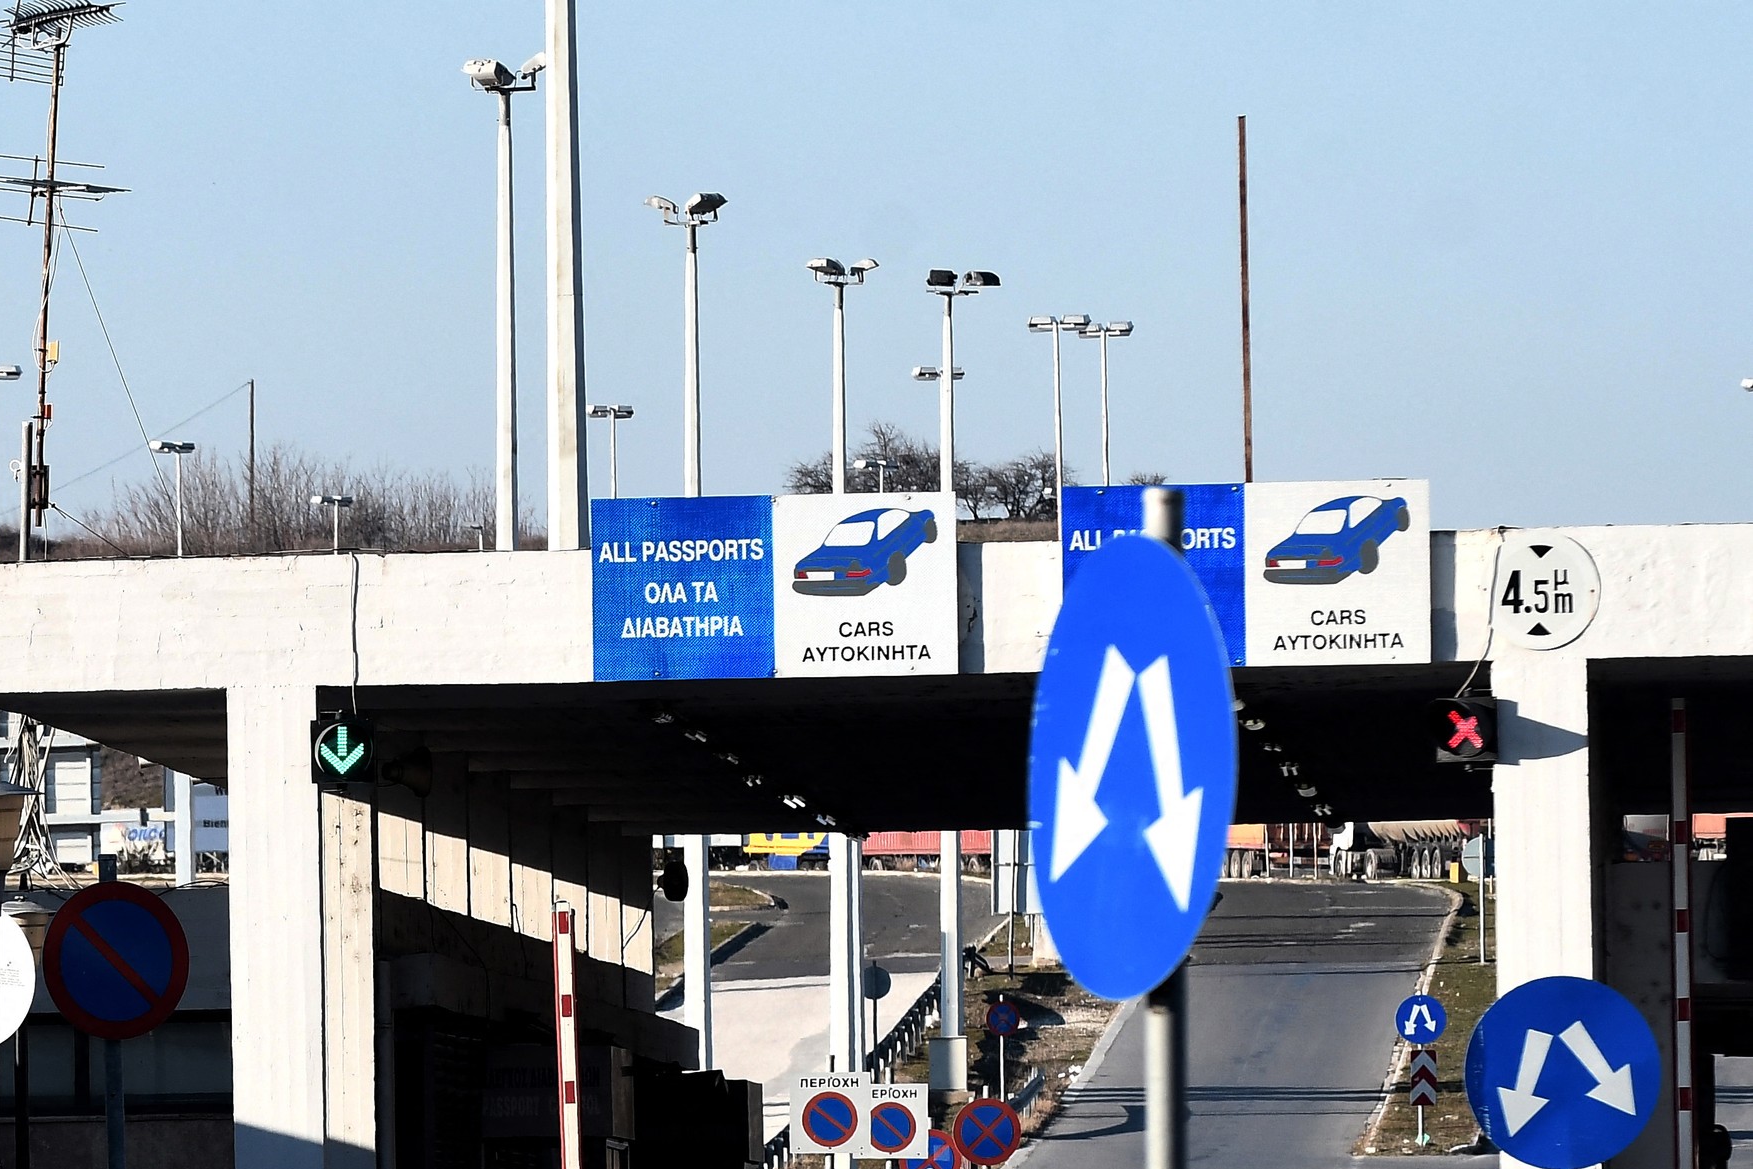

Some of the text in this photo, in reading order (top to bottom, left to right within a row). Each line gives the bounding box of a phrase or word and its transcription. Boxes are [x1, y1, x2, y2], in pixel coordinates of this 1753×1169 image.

[599, 538, 764, 563] ALL PASSPORTS
[644, 581, 719, 604] ΟΛΑ ΤΑ
[1501, 570, 1549, 614] 4.5
[621, 615, 744, 639] ΔΙΑΒΑΤΗΡΙΑ
[1310, 609, 1366, 626] CARS
[838, 621, 894, 638] CARS
[1273, 633, 1404, 651] ΑΥΤΟΚΙΝΗΤΑ
[802, 645, 932, 663] ΑΥΤΟΚΙΝΗΤΑ
[871, 1088, 918, 1099] ΕΡΙΟΧΗ
[482, 1096, 539, 1117] PASSPORT
